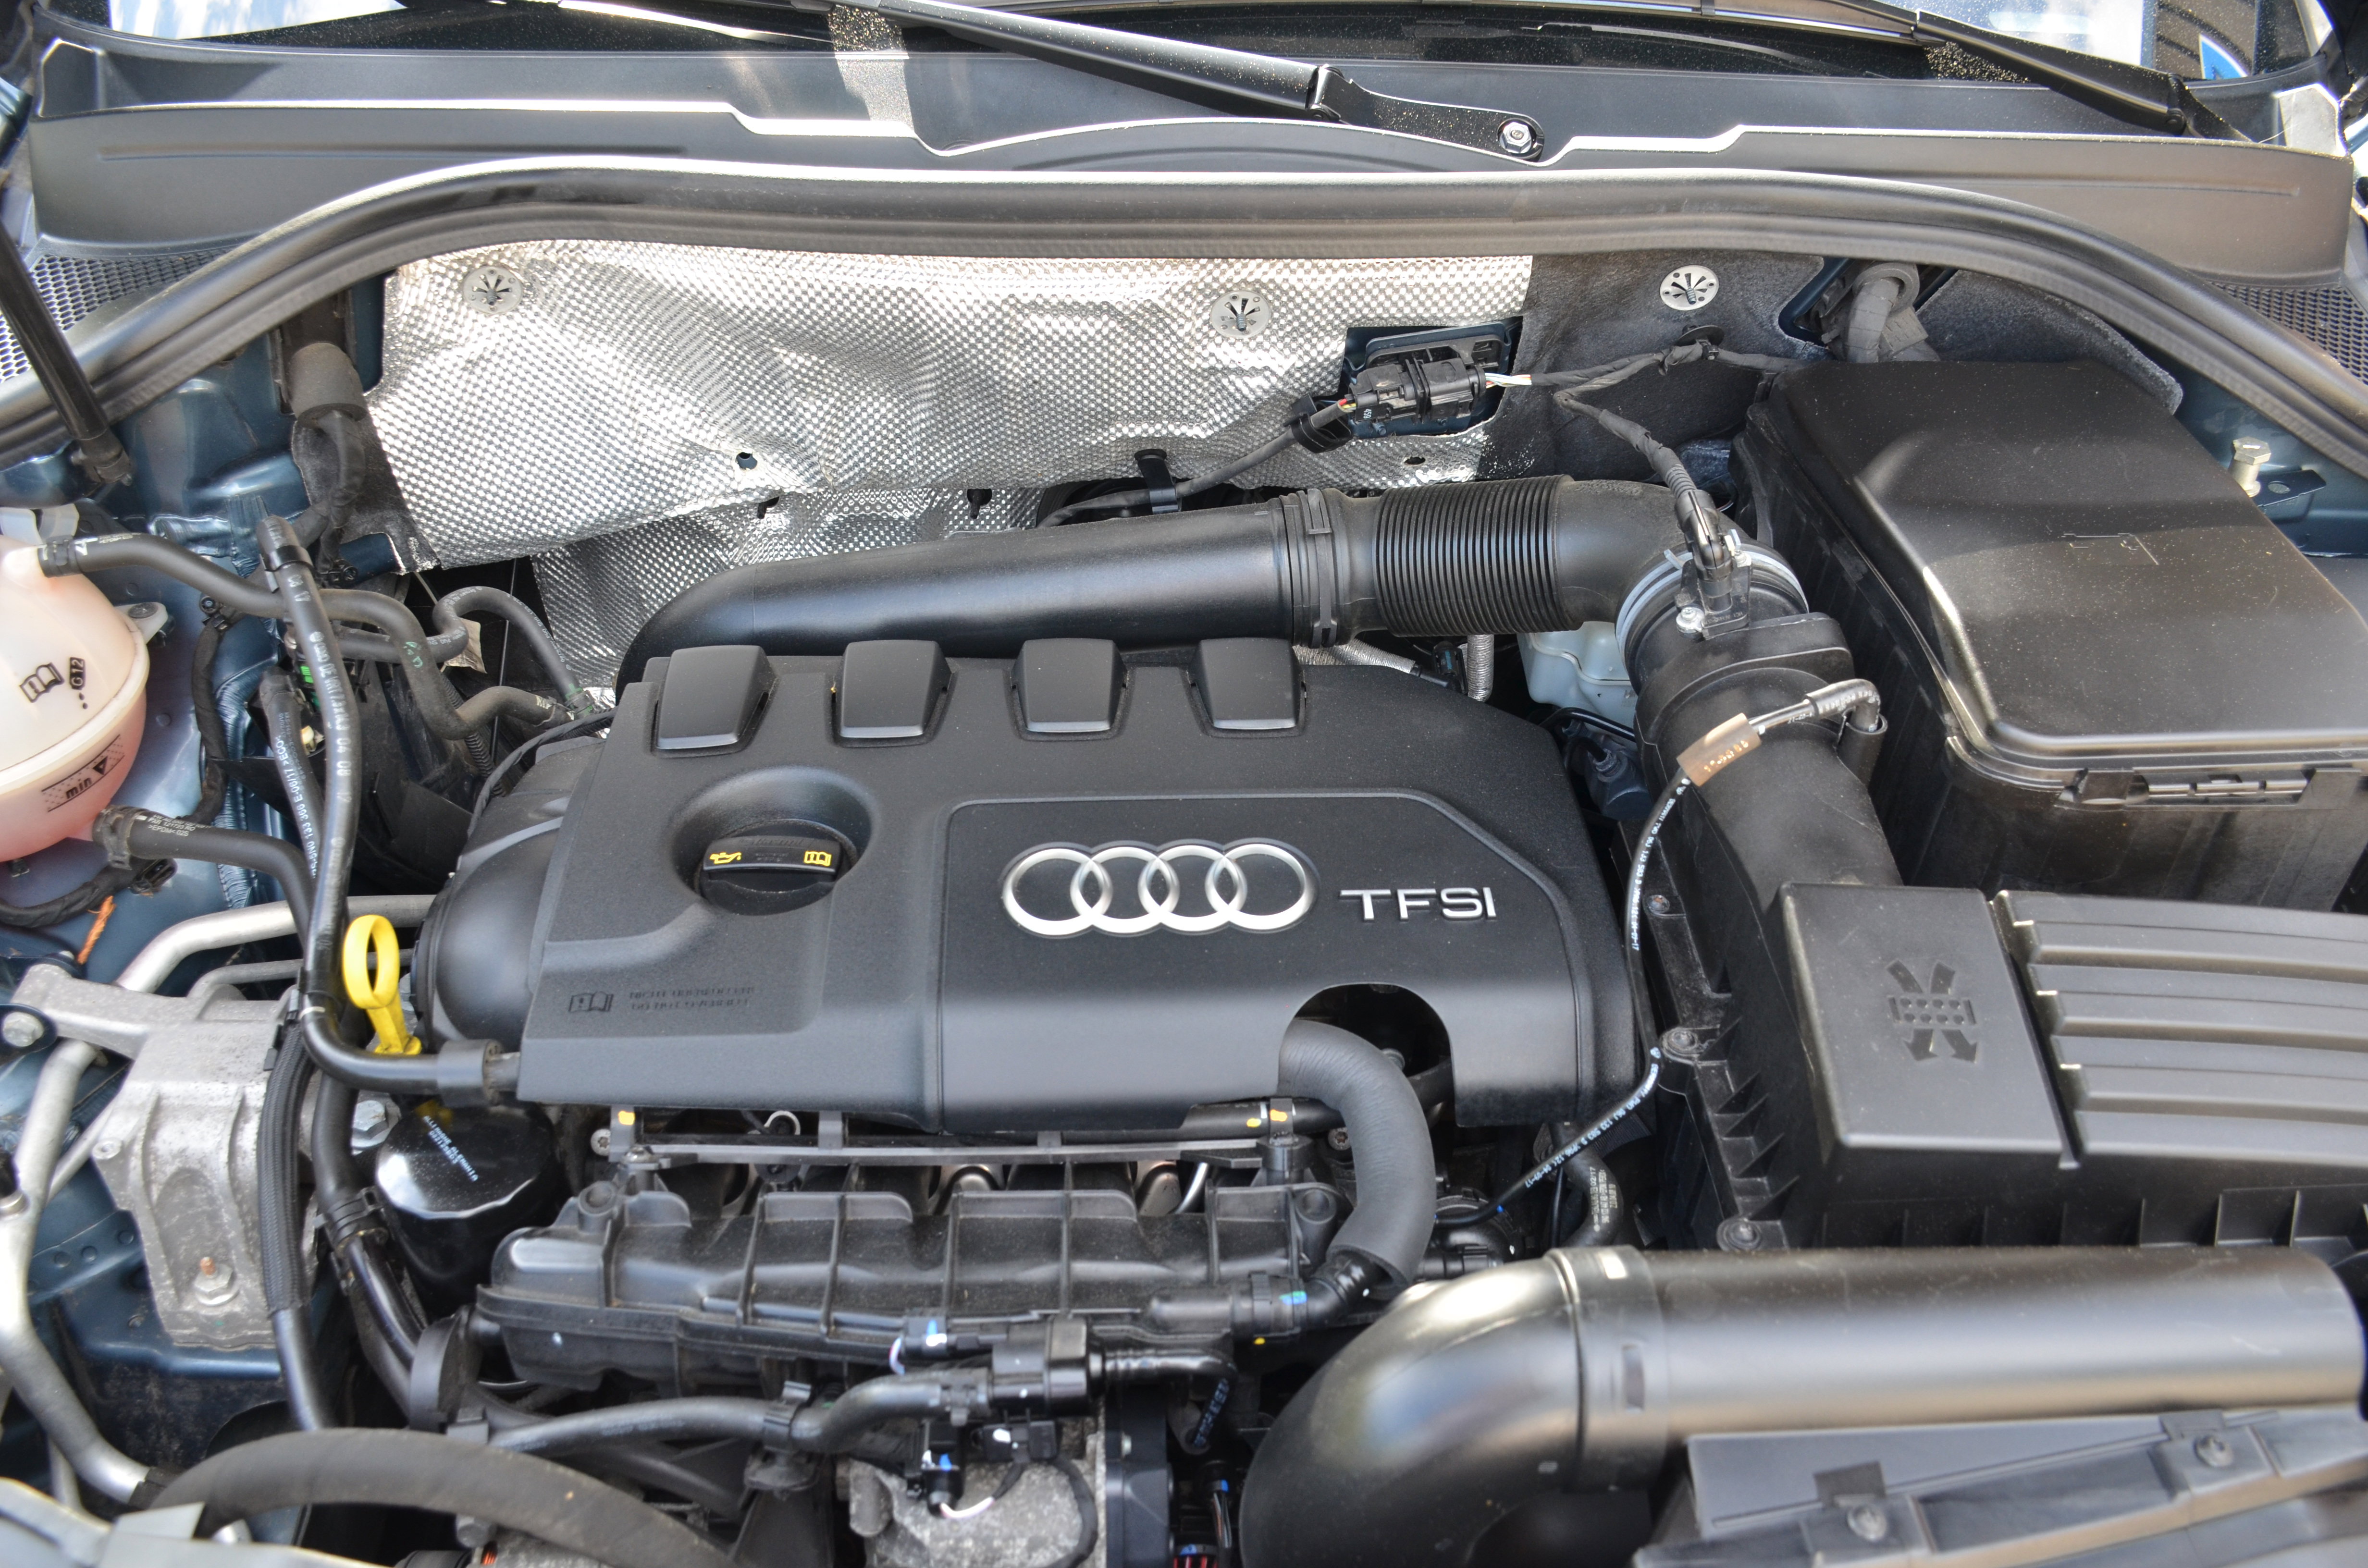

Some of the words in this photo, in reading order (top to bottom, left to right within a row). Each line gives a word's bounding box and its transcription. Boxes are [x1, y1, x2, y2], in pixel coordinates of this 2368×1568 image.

[1363, 408, 1372, 419] 459
[66, 777, 92, 799] min
[296, 804, 308, 821] 366
[148, 824, 175, 833] >EPDM<
[302, 822, 313, 839] 133
[1340, 887, 1497, 921] TFSI
